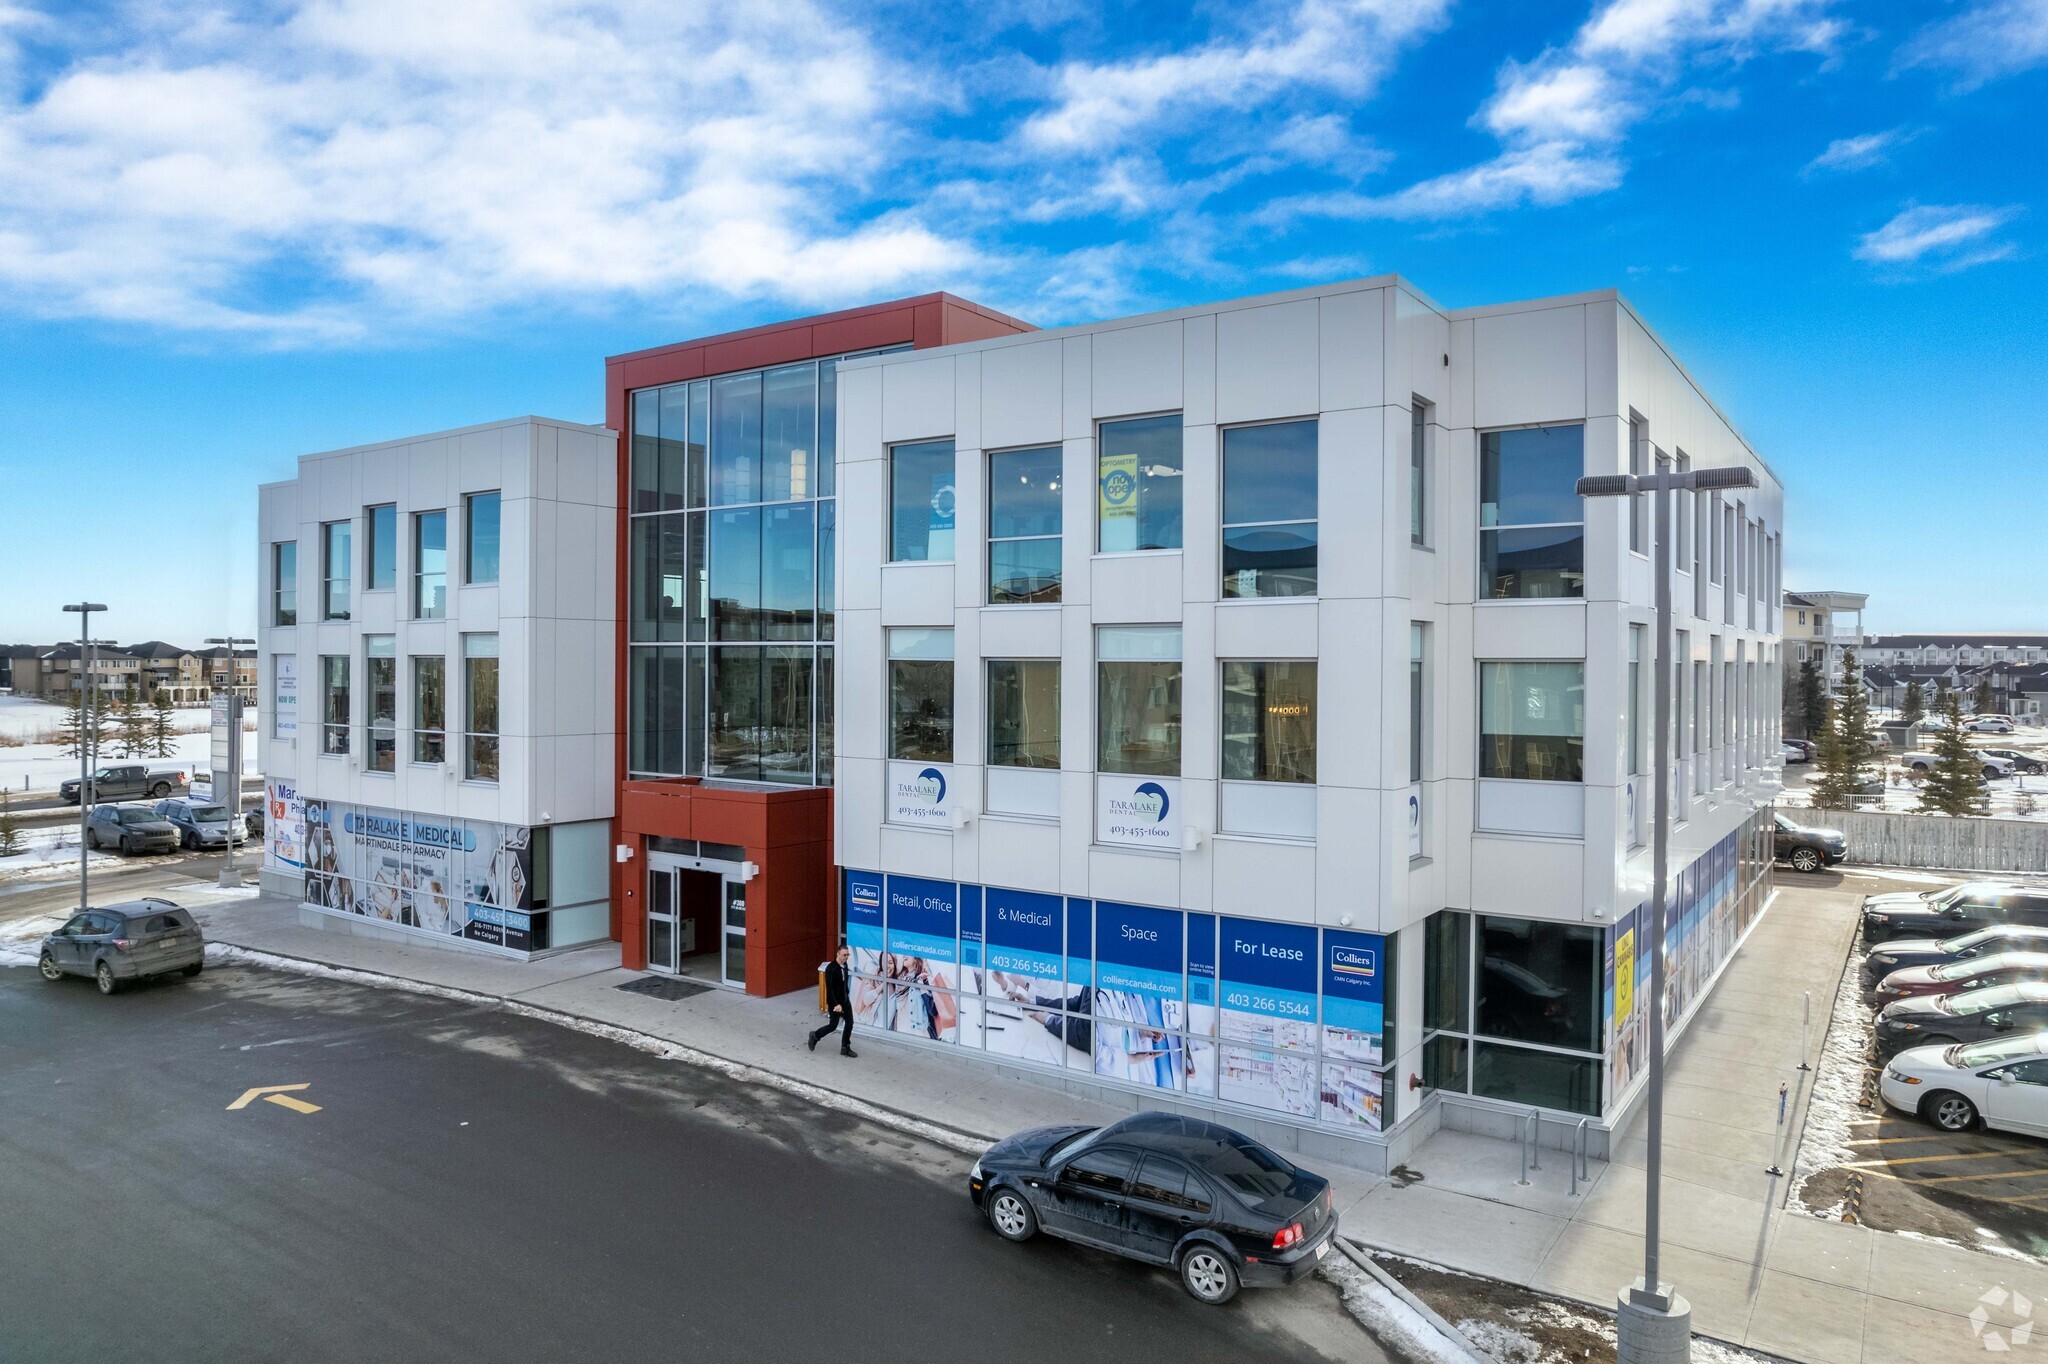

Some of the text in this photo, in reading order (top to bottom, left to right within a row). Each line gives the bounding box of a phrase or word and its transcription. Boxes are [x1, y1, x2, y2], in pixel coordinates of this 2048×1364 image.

[1101, 458, 1136, 468] OPTOMETRY
[898, 783, 937, 795] TARALAKE
[898, 807, 946, 817] 403-455-1600
[1109, 799, 1159, 812] TARALAKE
[355, 816, 463, 846] TARALAKE MEDICAL
[1109, 825, 1170, 838] 403-455-1600
[355, 836, 447, 860] MARTINDALE PHARMACY
[855, 887, 877, 898] Colliers
[506, 929, 524, 938] Avenue
[892, 893, 1304, 961] Retail, Office & Medical Space For Lease
[481, 931, 499, 942] Calgary
[892, 941, 952, 957] collierscanada.com
[1336, 951, 1370, 965] Colliers
[992, 955, 1057, 975] 403 266 5544
[1102, 975, 1176, 994] collierscanada.com
[1346, 977, 1362, 985] Calgary
[1227, 993, 1310, 1016] 403 266 5544
